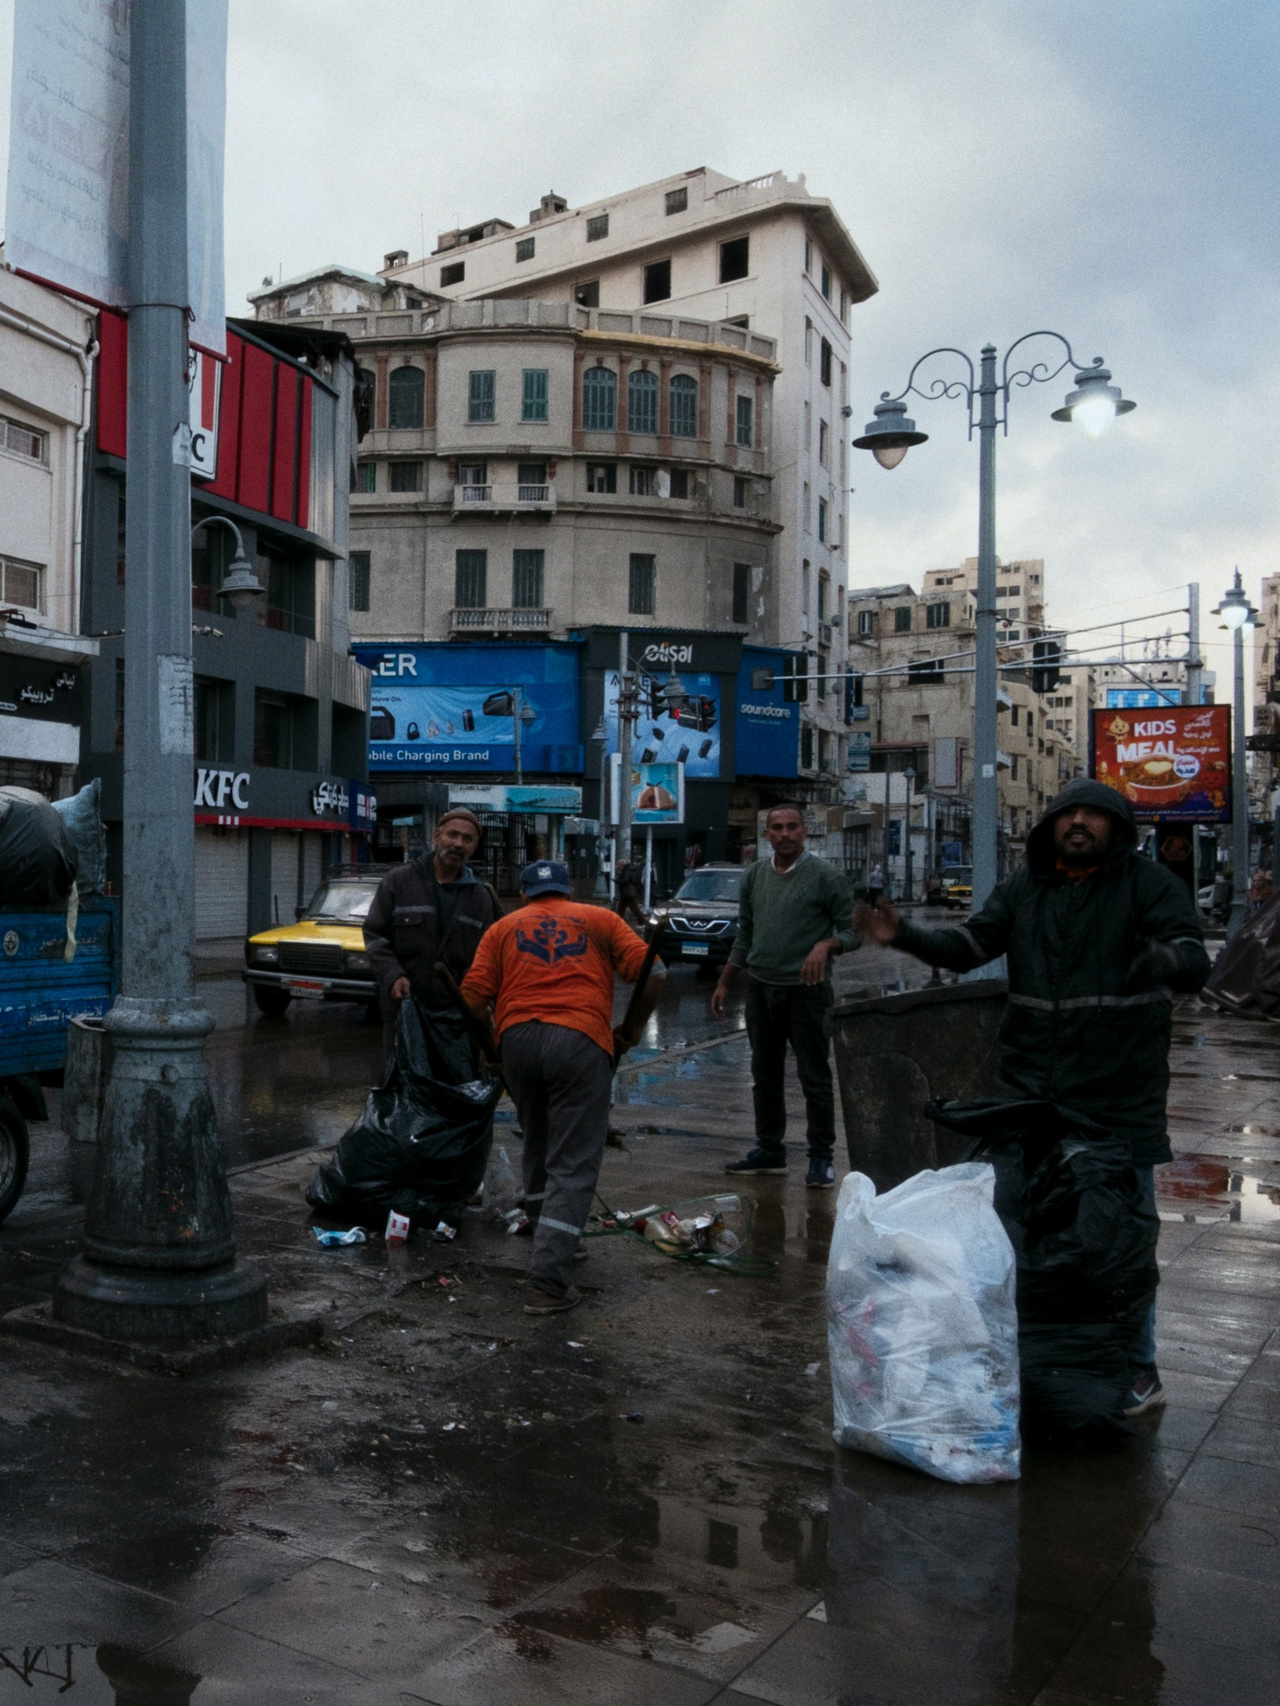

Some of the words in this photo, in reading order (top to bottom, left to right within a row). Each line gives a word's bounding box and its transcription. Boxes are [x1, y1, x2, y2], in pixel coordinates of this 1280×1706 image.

[740, 701, 791, 719] soundcore
[1133, 719, 1177, 737] KIDS
[396, 750, 450, 763] Charging
[453, 750, 489, 761] Brand
[1116, 740, 1177, 763] MEAL
[194, 768, 251, 810] KFC
